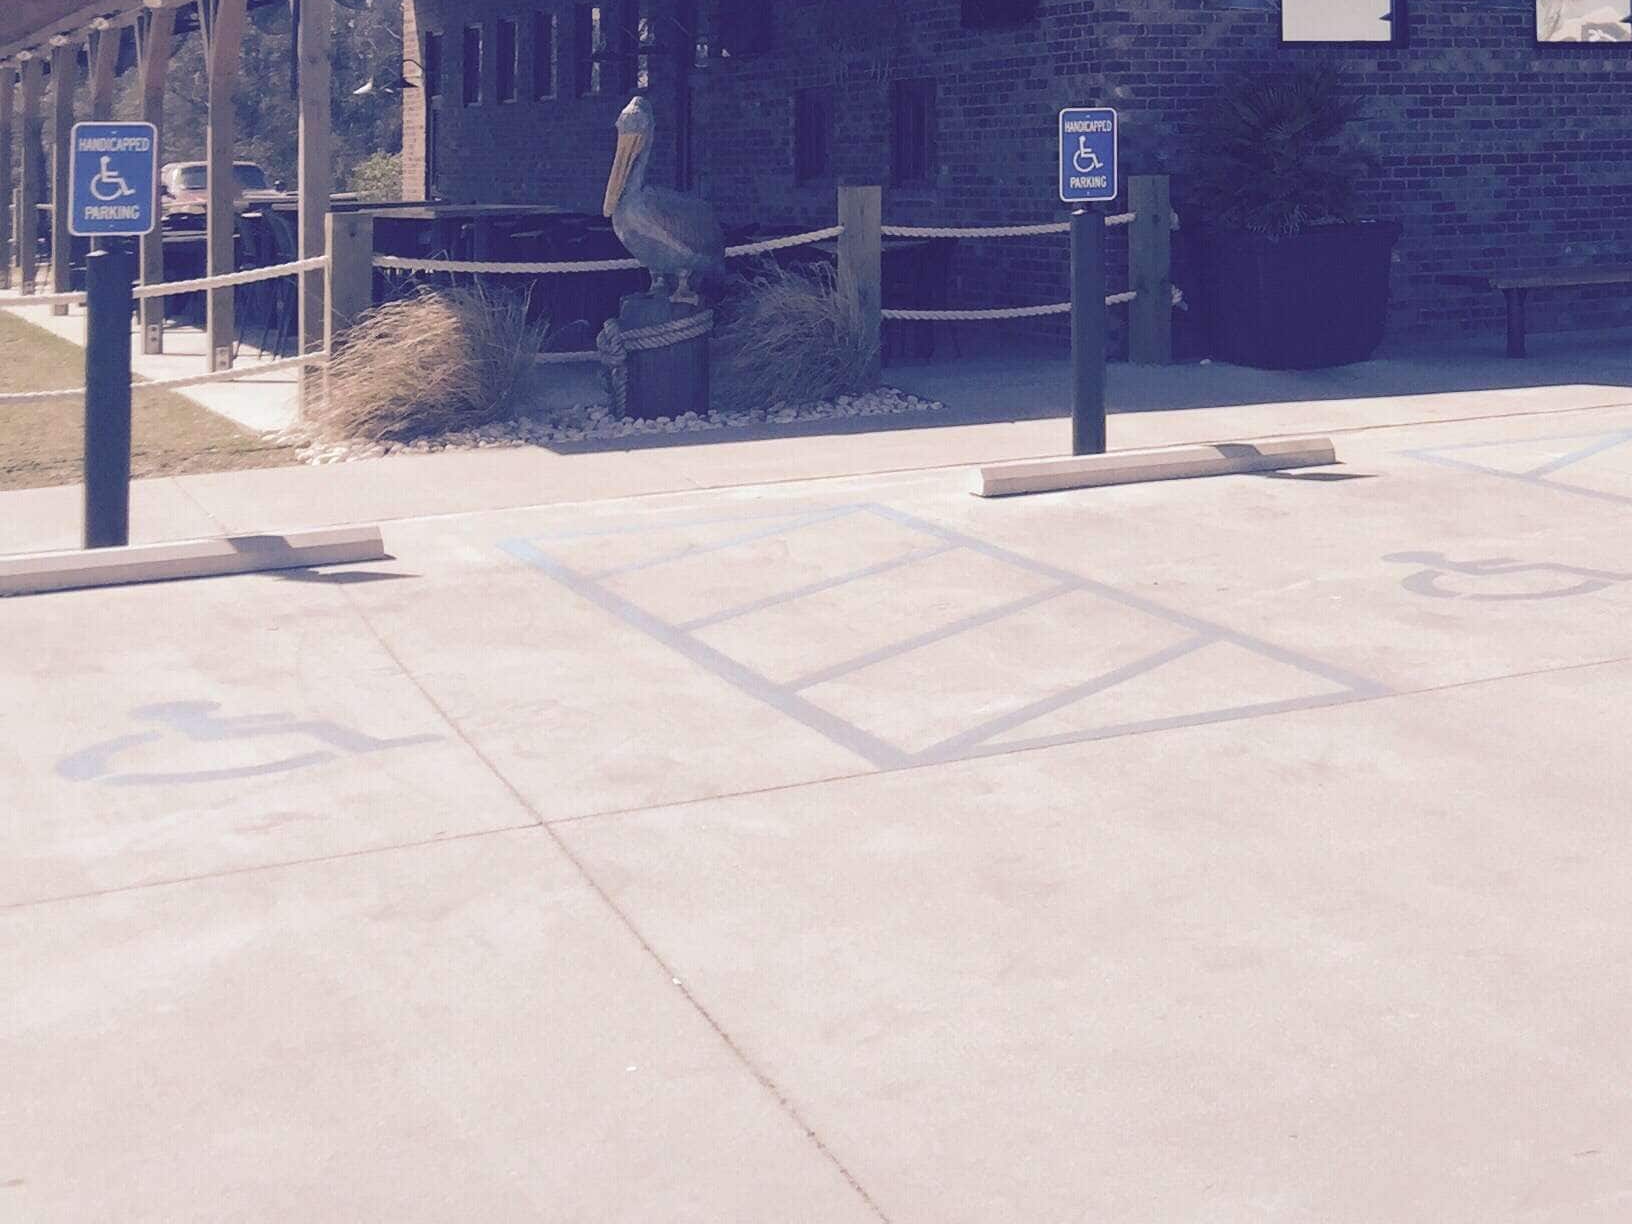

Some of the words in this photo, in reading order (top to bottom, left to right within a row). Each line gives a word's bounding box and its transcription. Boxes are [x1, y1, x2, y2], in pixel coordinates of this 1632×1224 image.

[1065, 120, 1113, 133] HANDICAPPED
[78, 137, 150, 152] HANDICAPPED
[1070, 176, 1107, 189] PARKING
[84, 206, 140, 220] PARKING
